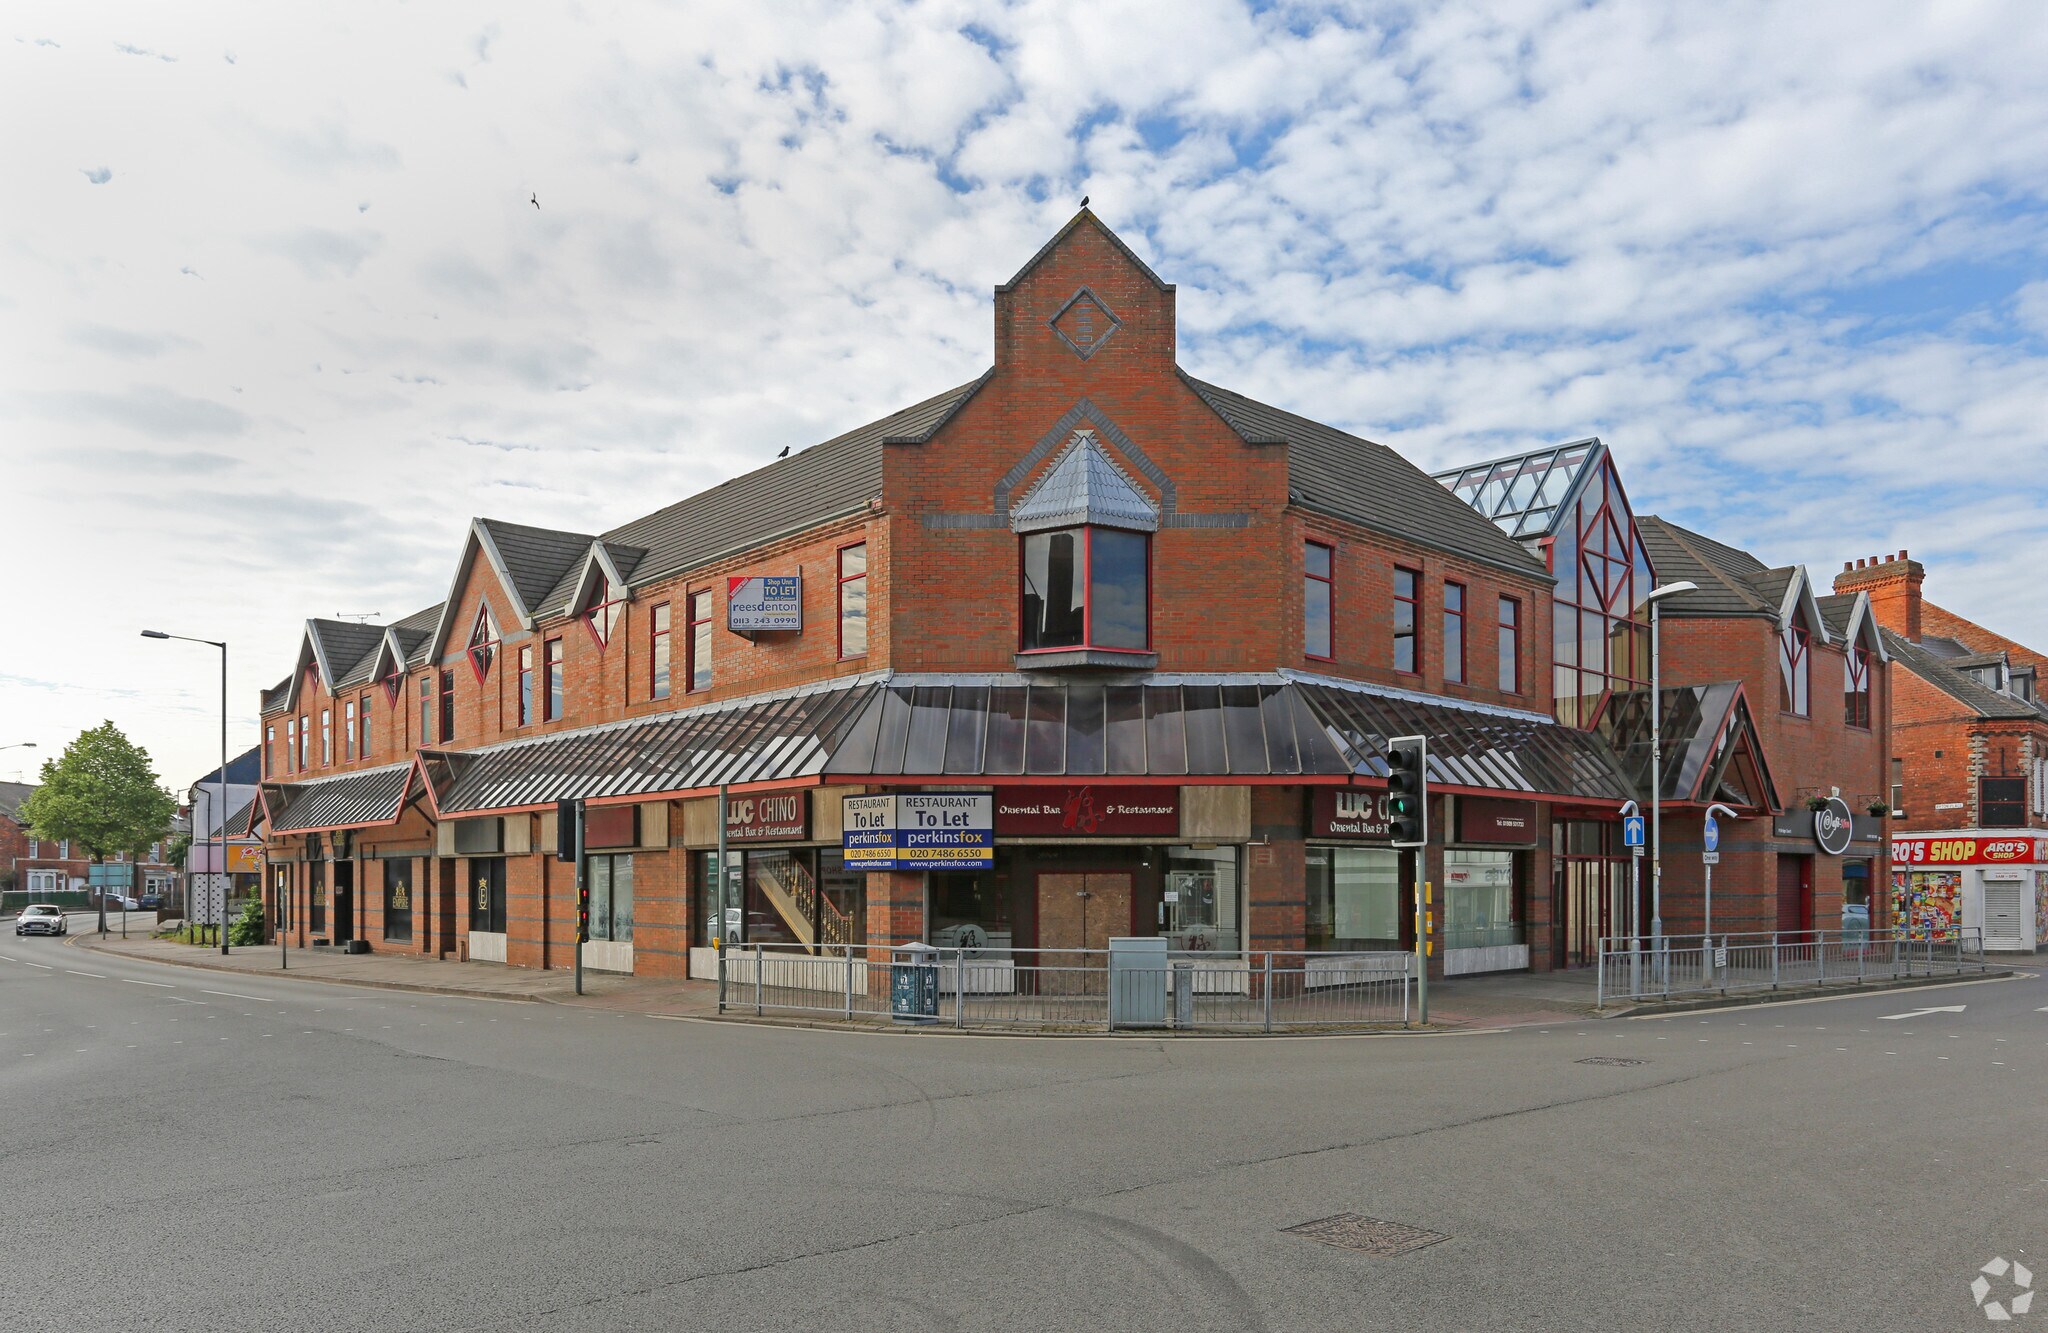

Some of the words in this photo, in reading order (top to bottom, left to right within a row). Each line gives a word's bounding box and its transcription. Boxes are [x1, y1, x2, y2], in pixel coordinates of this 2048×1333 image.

[767, 578, 781, 586] Shop
[765, 586, 777, 595] TO
[780, 586, 796, 595] LET
[733, 601, 797, 611] reesdenton
[848, 798, 890, 810] RESTAURANT
[906, 797, 978, 807] RESTAURANT
[1336, 792, 1373, 819] LUC
[727, 800, 755, 825] LUC
[759, 796, 797, 823] CHINO
[999, 804, 1040, 814] Oriental
[1043, 805, 1061, 814] Bar
[1106, 805, 1115, 814] &
[1118, 805, 1173, 814] Restaurant
[853, 812, 867, 828] To
[869, 811, 885, 828] Let
[915, 810, 937, 827] To
[942, 810, 969, 827] Let
[745, 826, 757, 837] Bar
[758, 826, 765, 836] &
[765, 825, 803, 836] Restaurant
[1330, 821, 1361, 833] Oriental
[1362, 822, 1375, 833] Bar
[1376, 823, 1382, 833] &
[849, 831, 892, 848] perkinsfox
[907, 830, 983, 847] perkinsfox
[1892, 841, 1925, 862] RO'S
[1930, 840, 1977, 861] SHOP
[1987, 842, 2027, 853] ARO'S
[850, 849, 862, 858] 020
[862, 849, 876, 858] 7486
[877, 849, 891, 858] 6550
[910, 849, 928, 858] 020
[931, 849, 955, 858] 7486
[957, 849, 981, 858] 6550
[850, 860, 892, 868] www.perkinsfox.com
[909, 860, 983, 868] www.perkinsfox.com
